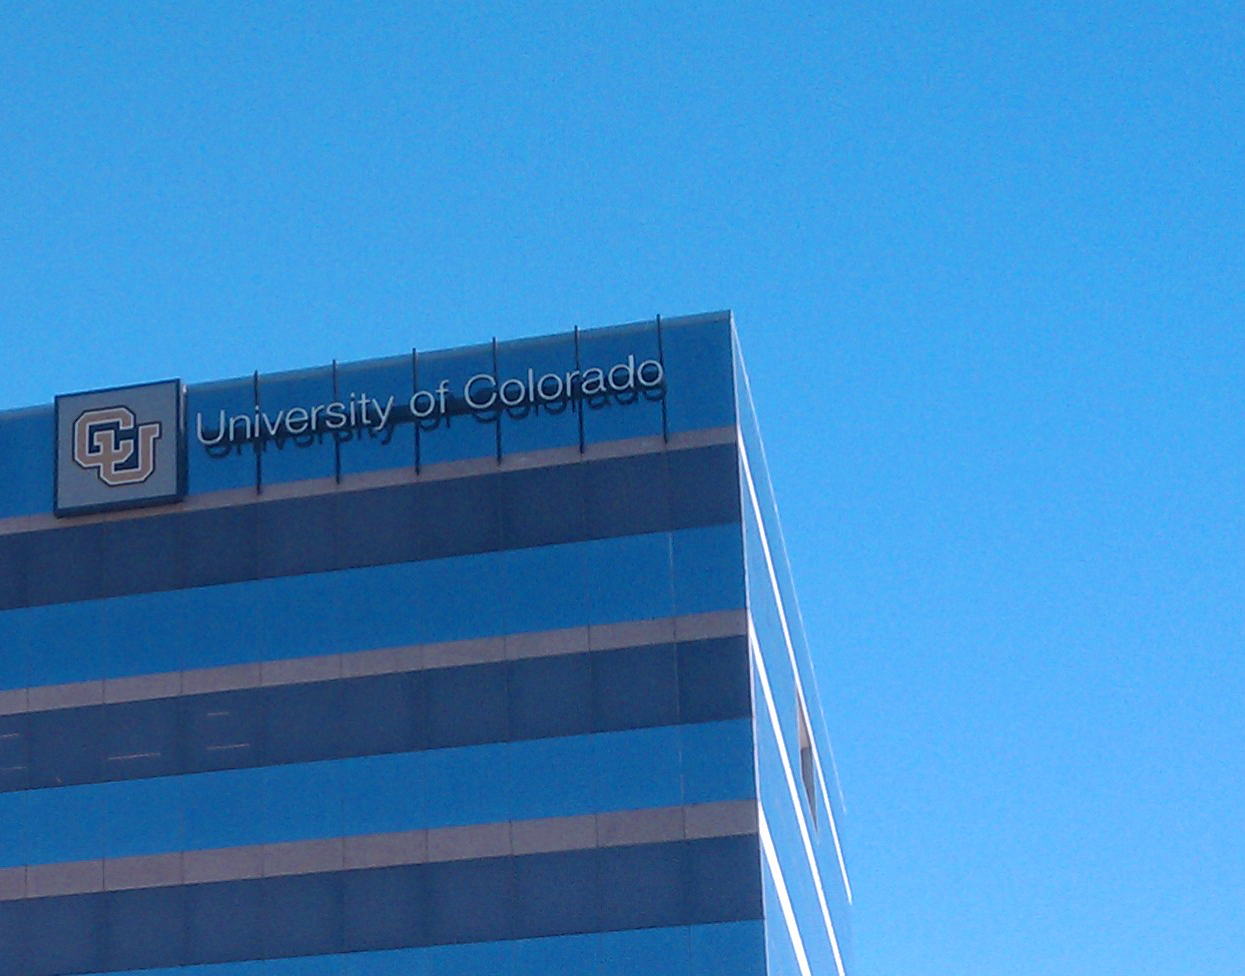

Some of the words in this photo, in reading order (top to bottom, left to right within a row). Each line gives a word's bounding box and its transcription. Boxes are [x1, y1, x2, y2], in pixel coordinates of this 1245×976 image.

[195, 390, 395, 445] University
[409, 380, 449, 417] of
[463, 354, 665, 411] Colorado
[73, 406, 162, 486] CU
